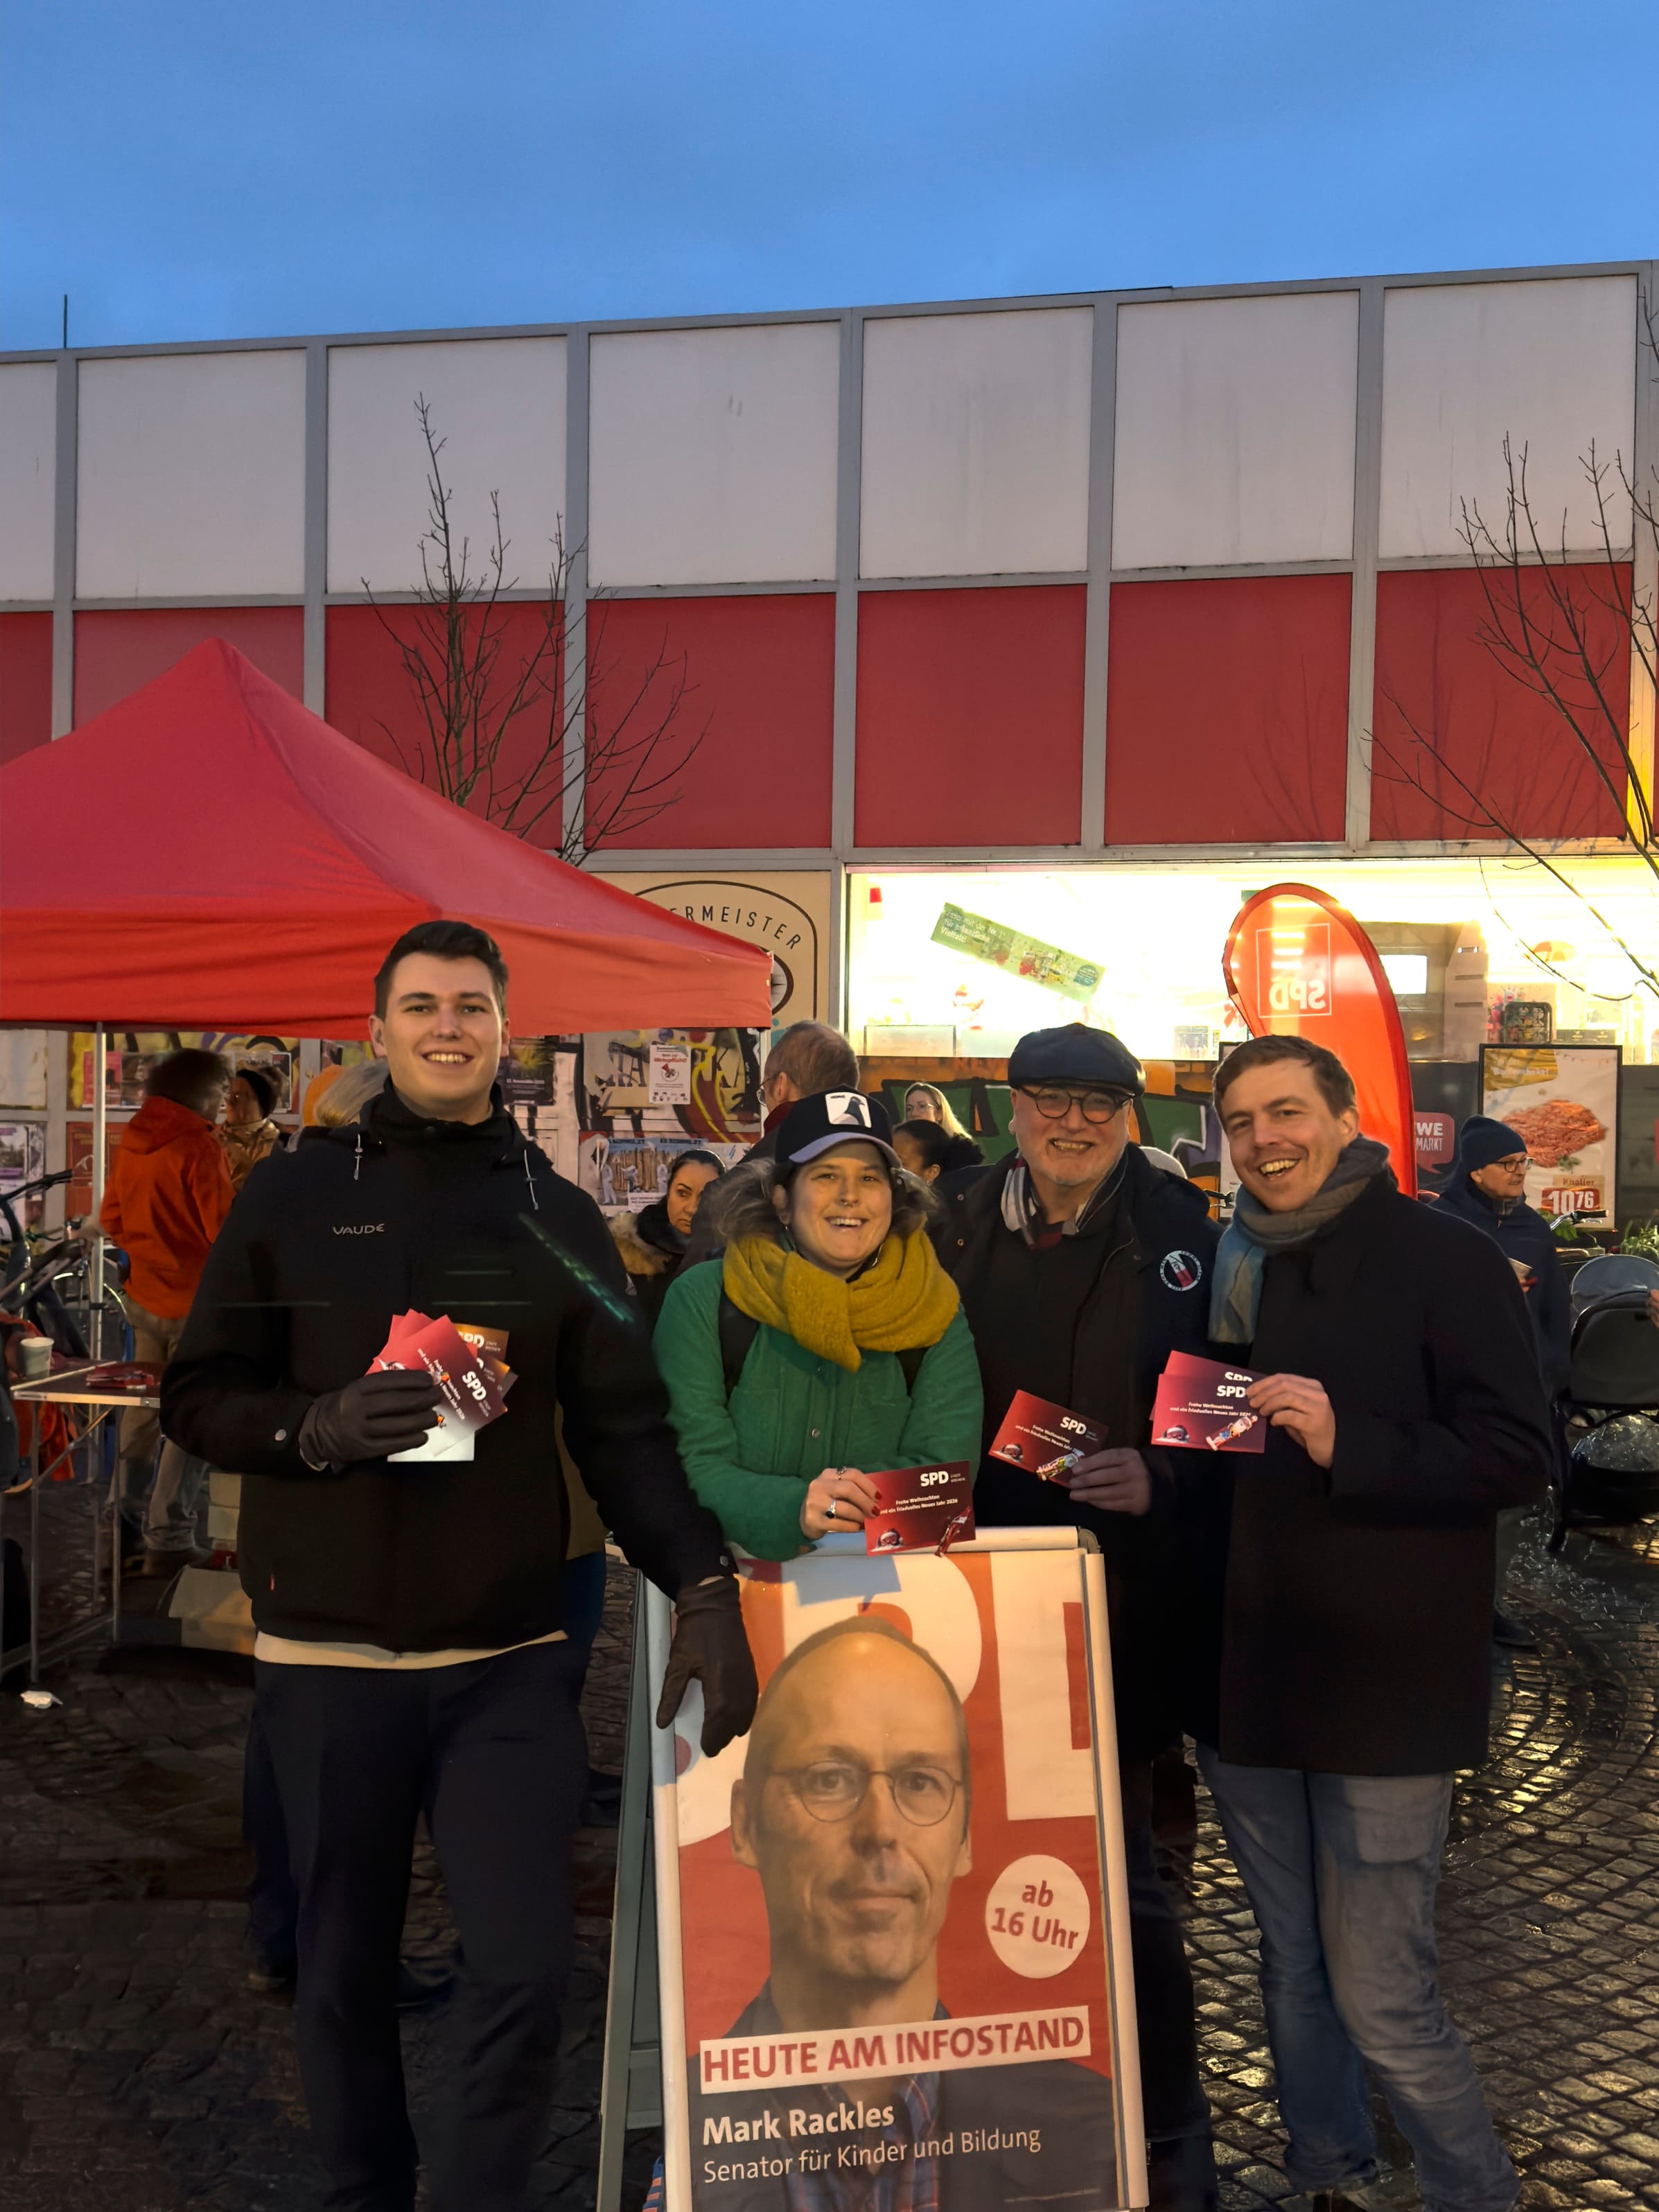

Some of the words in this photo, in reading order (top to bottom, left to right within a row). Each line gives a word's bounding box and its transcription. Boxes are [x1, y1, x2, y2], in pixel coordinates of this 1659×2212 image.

[669, 905, 801, 949] RMEISTER
[1414, 1122, 1443, 1136] WE
[1416, 1137, 1443, 1151] MARKT
[1563, 1177, 1595, 1186] Knaller
[333, 1223, 385, 1235] VAUDE
[462, 1371, 486, 1401] SPD
[1216, 1385, 1247, 1398] SPD
[1060, 1416, 1087, 1435] SPD
[1044, 1430, 1071, 1443] Weihnachten
[920, 1471, 949, 1487] SPD
[909, 1494, 940, 1503] Weihnachten
[1021, 1880, 1054, 1907] ab
[991, 1907, 1025, 1936] 16
[1032, 1915, 1079, 1949] Uhr
[703, 2042, 818, 2082] HEUTE
[827, 2035, 887, 2071] AM
[895, 2017, 1085, 2064] INFOSTAND
[702, 2111, 782, 2146] Mark
[789, 2101, 895, 2138] Rackles
[703, 2157, 793, 2184] Senator
[799, 2149, 832, 2175] für
[837, 2140, 909, 2168] Kinder
[914, 2134, 954, 2161] und
[961, 2127, 1042, 2155] Bildung
